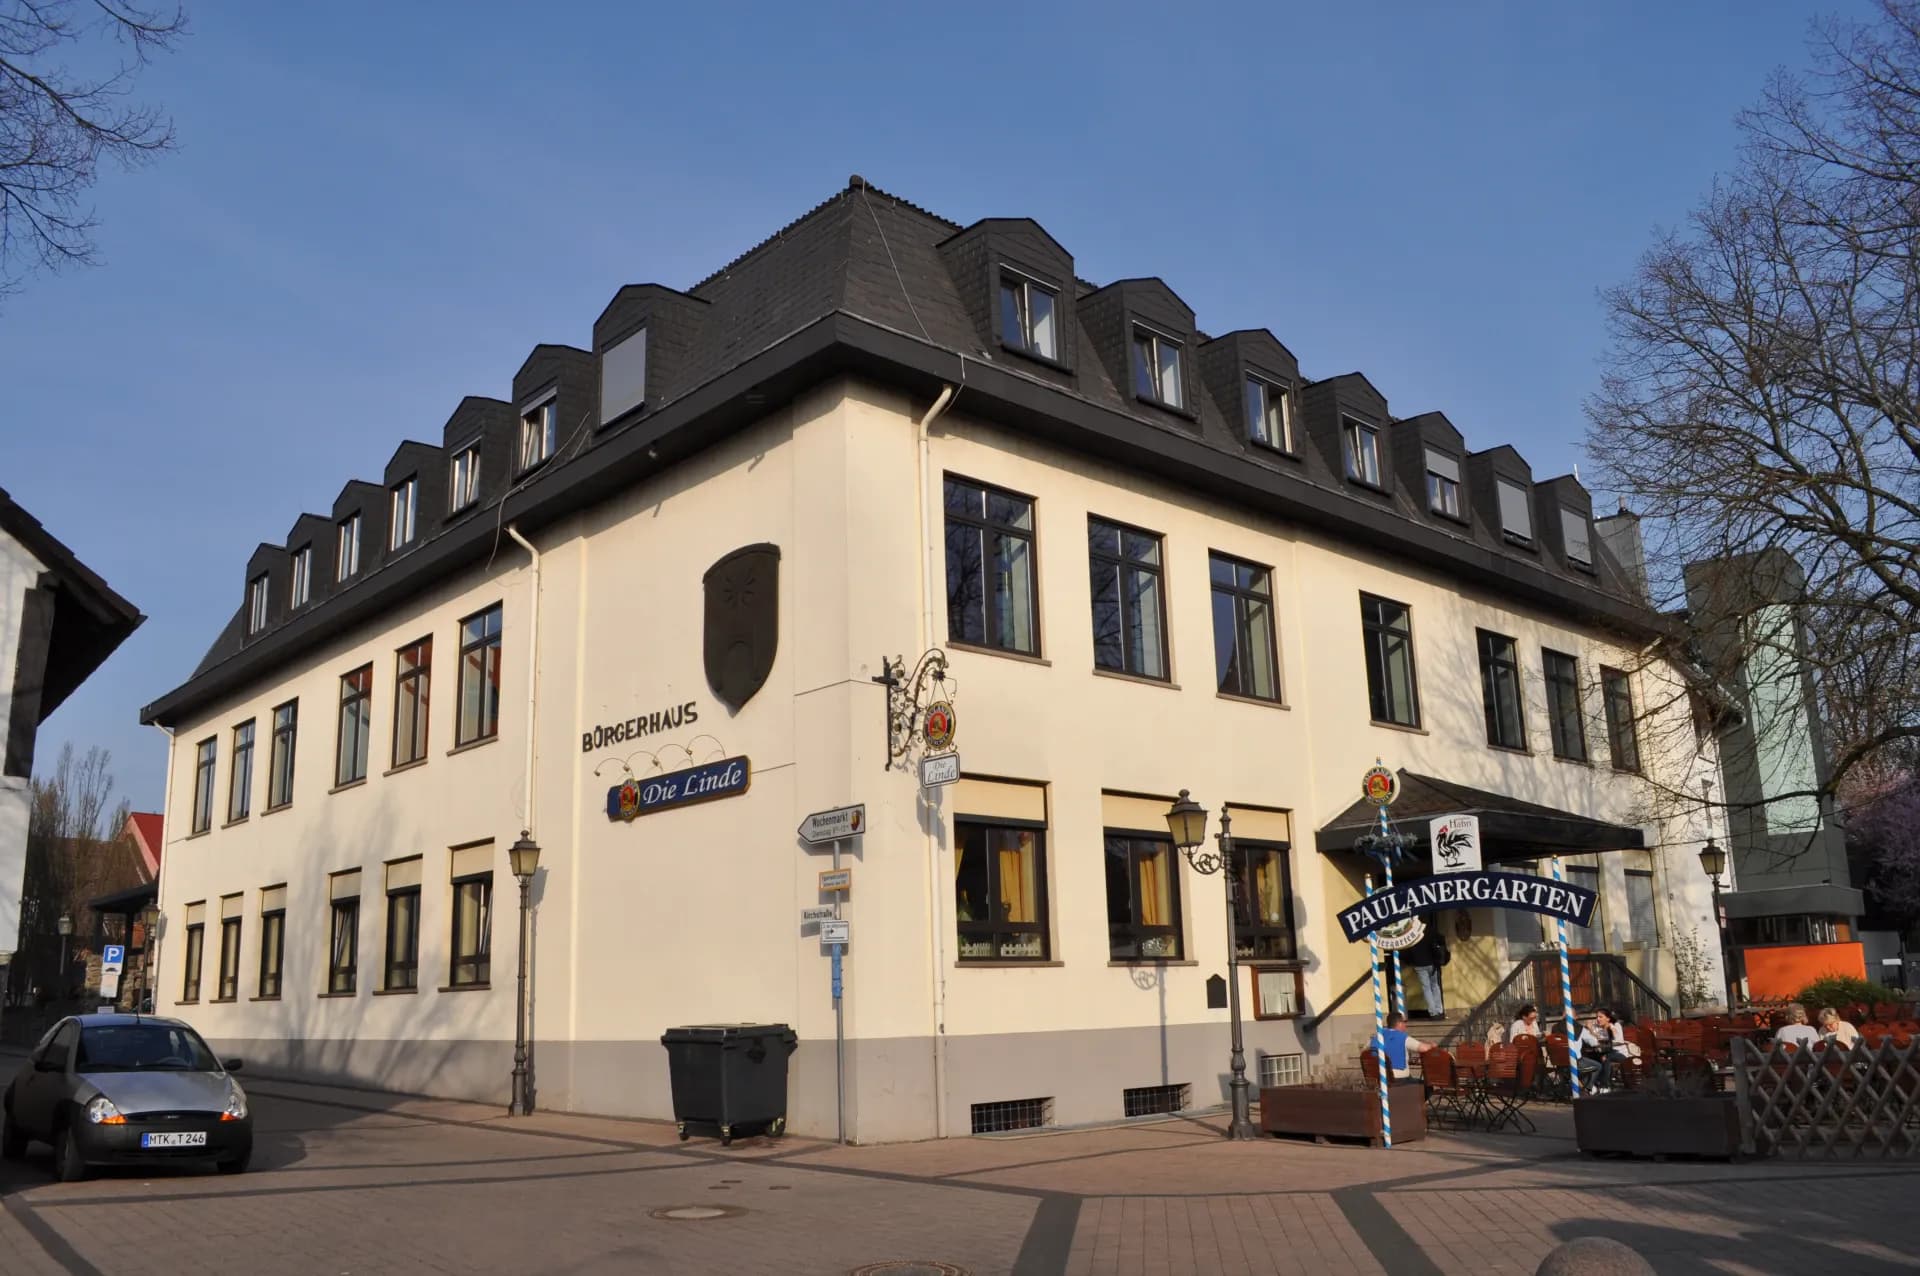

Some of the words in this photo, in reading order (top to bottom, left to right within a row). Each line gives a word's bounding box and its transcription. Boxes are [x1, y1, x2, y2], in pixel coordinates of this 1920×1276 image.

[927, 767, 955, 782] Linde
[643, 780, 676, 804] Die
[682, 762, 742, 797] Linde
[812, 811, 849, 829] Wochenmarkt
[1345, 877, 1586, 935] PAULANERGARTEN
[107, 947, 120, 962] P
[149, 1134, 170, 1145] MTK
[178, 1134, 184, 1145] T
[185, 1133, 205, 1144] 246
